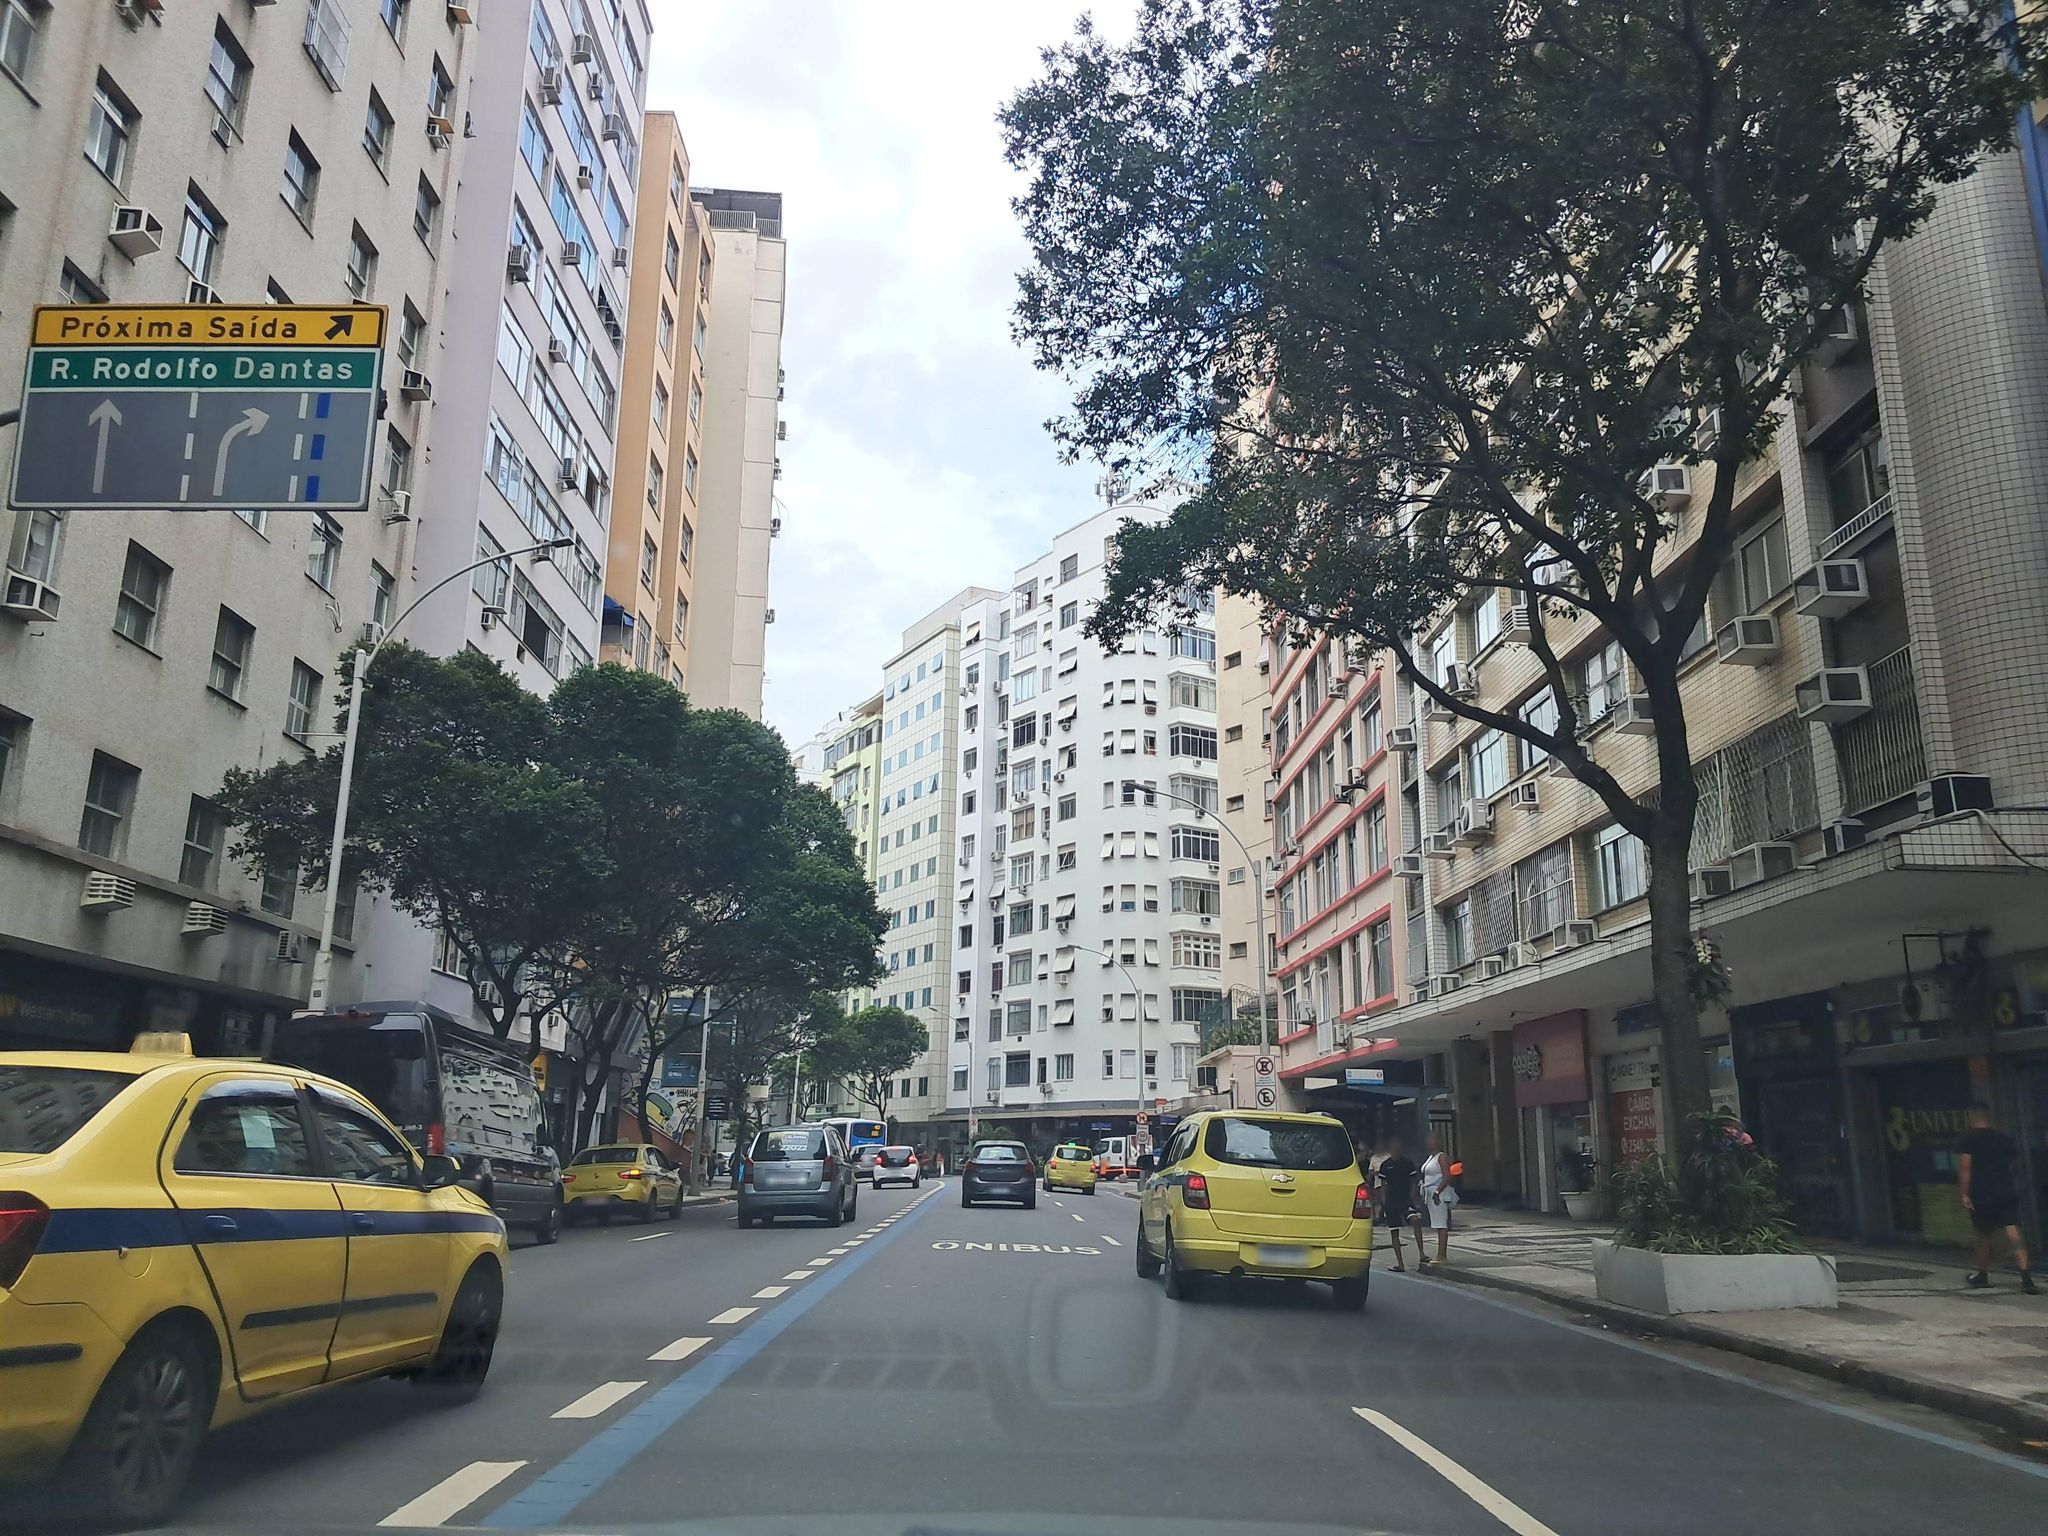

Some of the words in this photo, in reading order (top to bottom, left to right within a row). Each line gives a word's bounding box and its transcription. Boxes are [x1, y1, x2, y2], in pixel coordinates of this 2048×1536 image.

[61, 315, 193, 339] Próxima
[208, 315, 297, 338] Saída
[50, 358, 78, 380] R.
[93, 357, 218, 380] Rodolfo
[234, 356, 353, 380] Dantas
[1627, 1093, 1652, 1112] CÂMB
